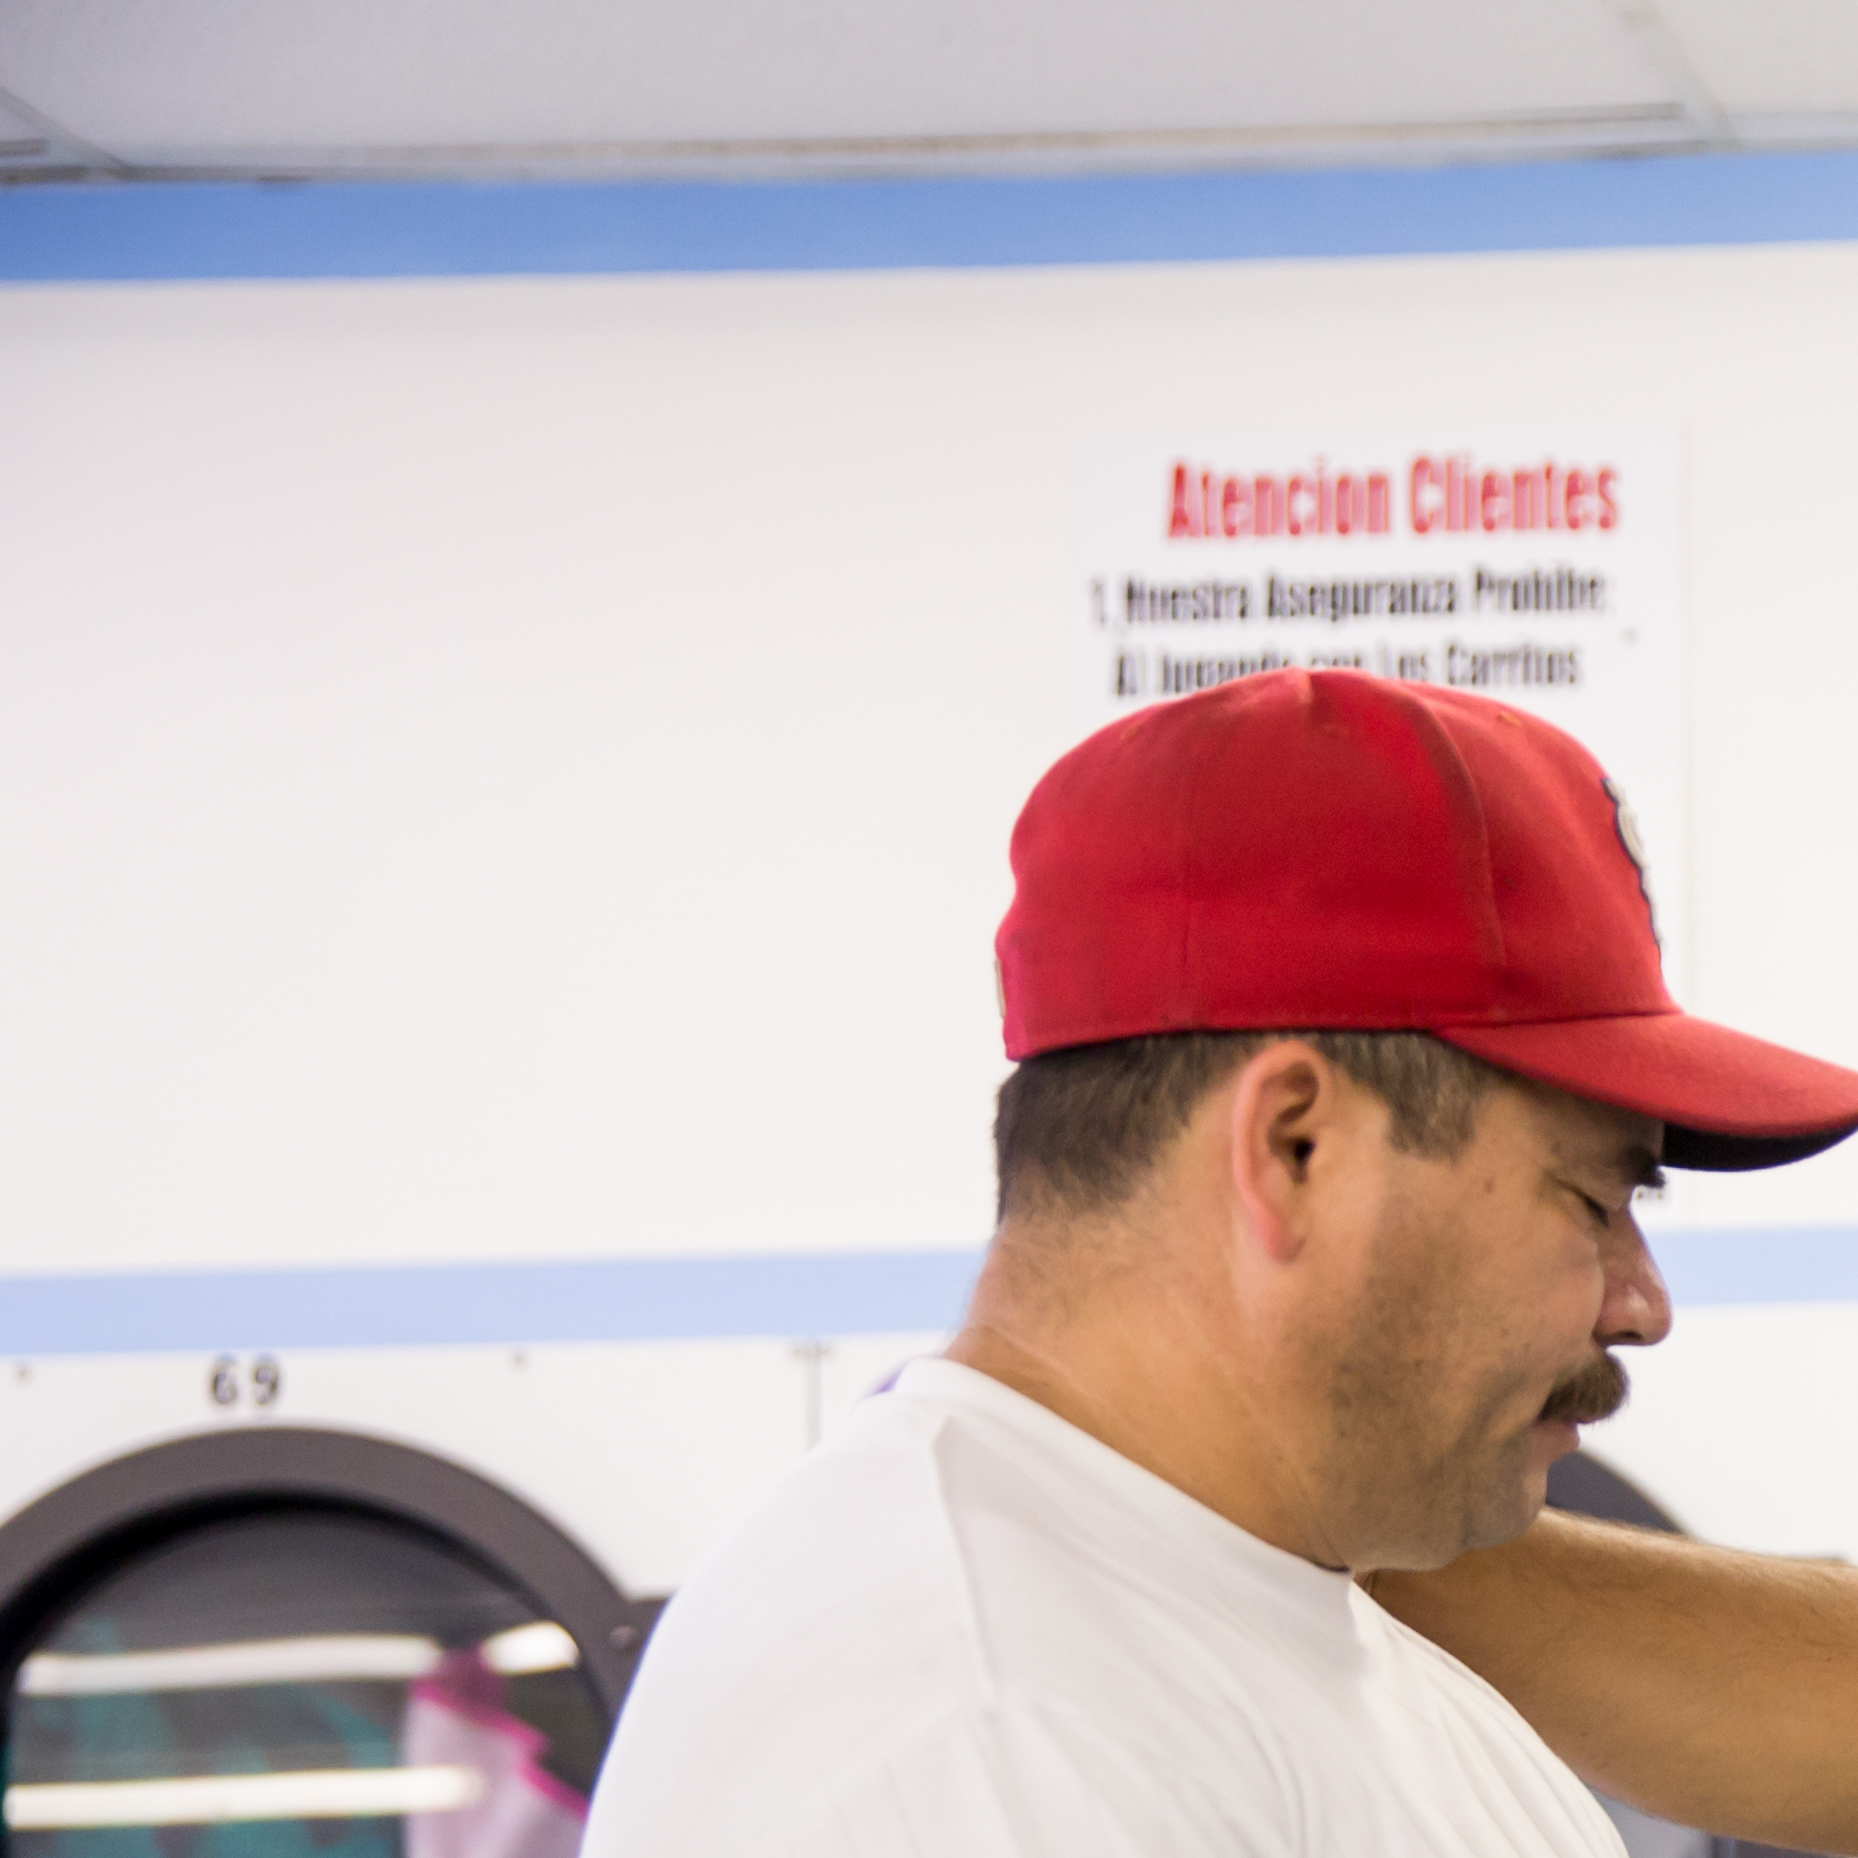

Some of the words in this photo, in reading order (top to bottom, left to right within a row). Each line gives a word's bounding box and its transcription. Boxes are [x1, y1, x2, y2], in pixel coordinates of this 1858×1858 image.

[1166, 458, 1392, 537] Atencion
[1408, 455, 1620, 534] Clientes
[1124, 574, 1250, 626] Nuestra
[1265, 570, 1457, 626] Aseguranza
[207, 1350, 281, 1407] 69
